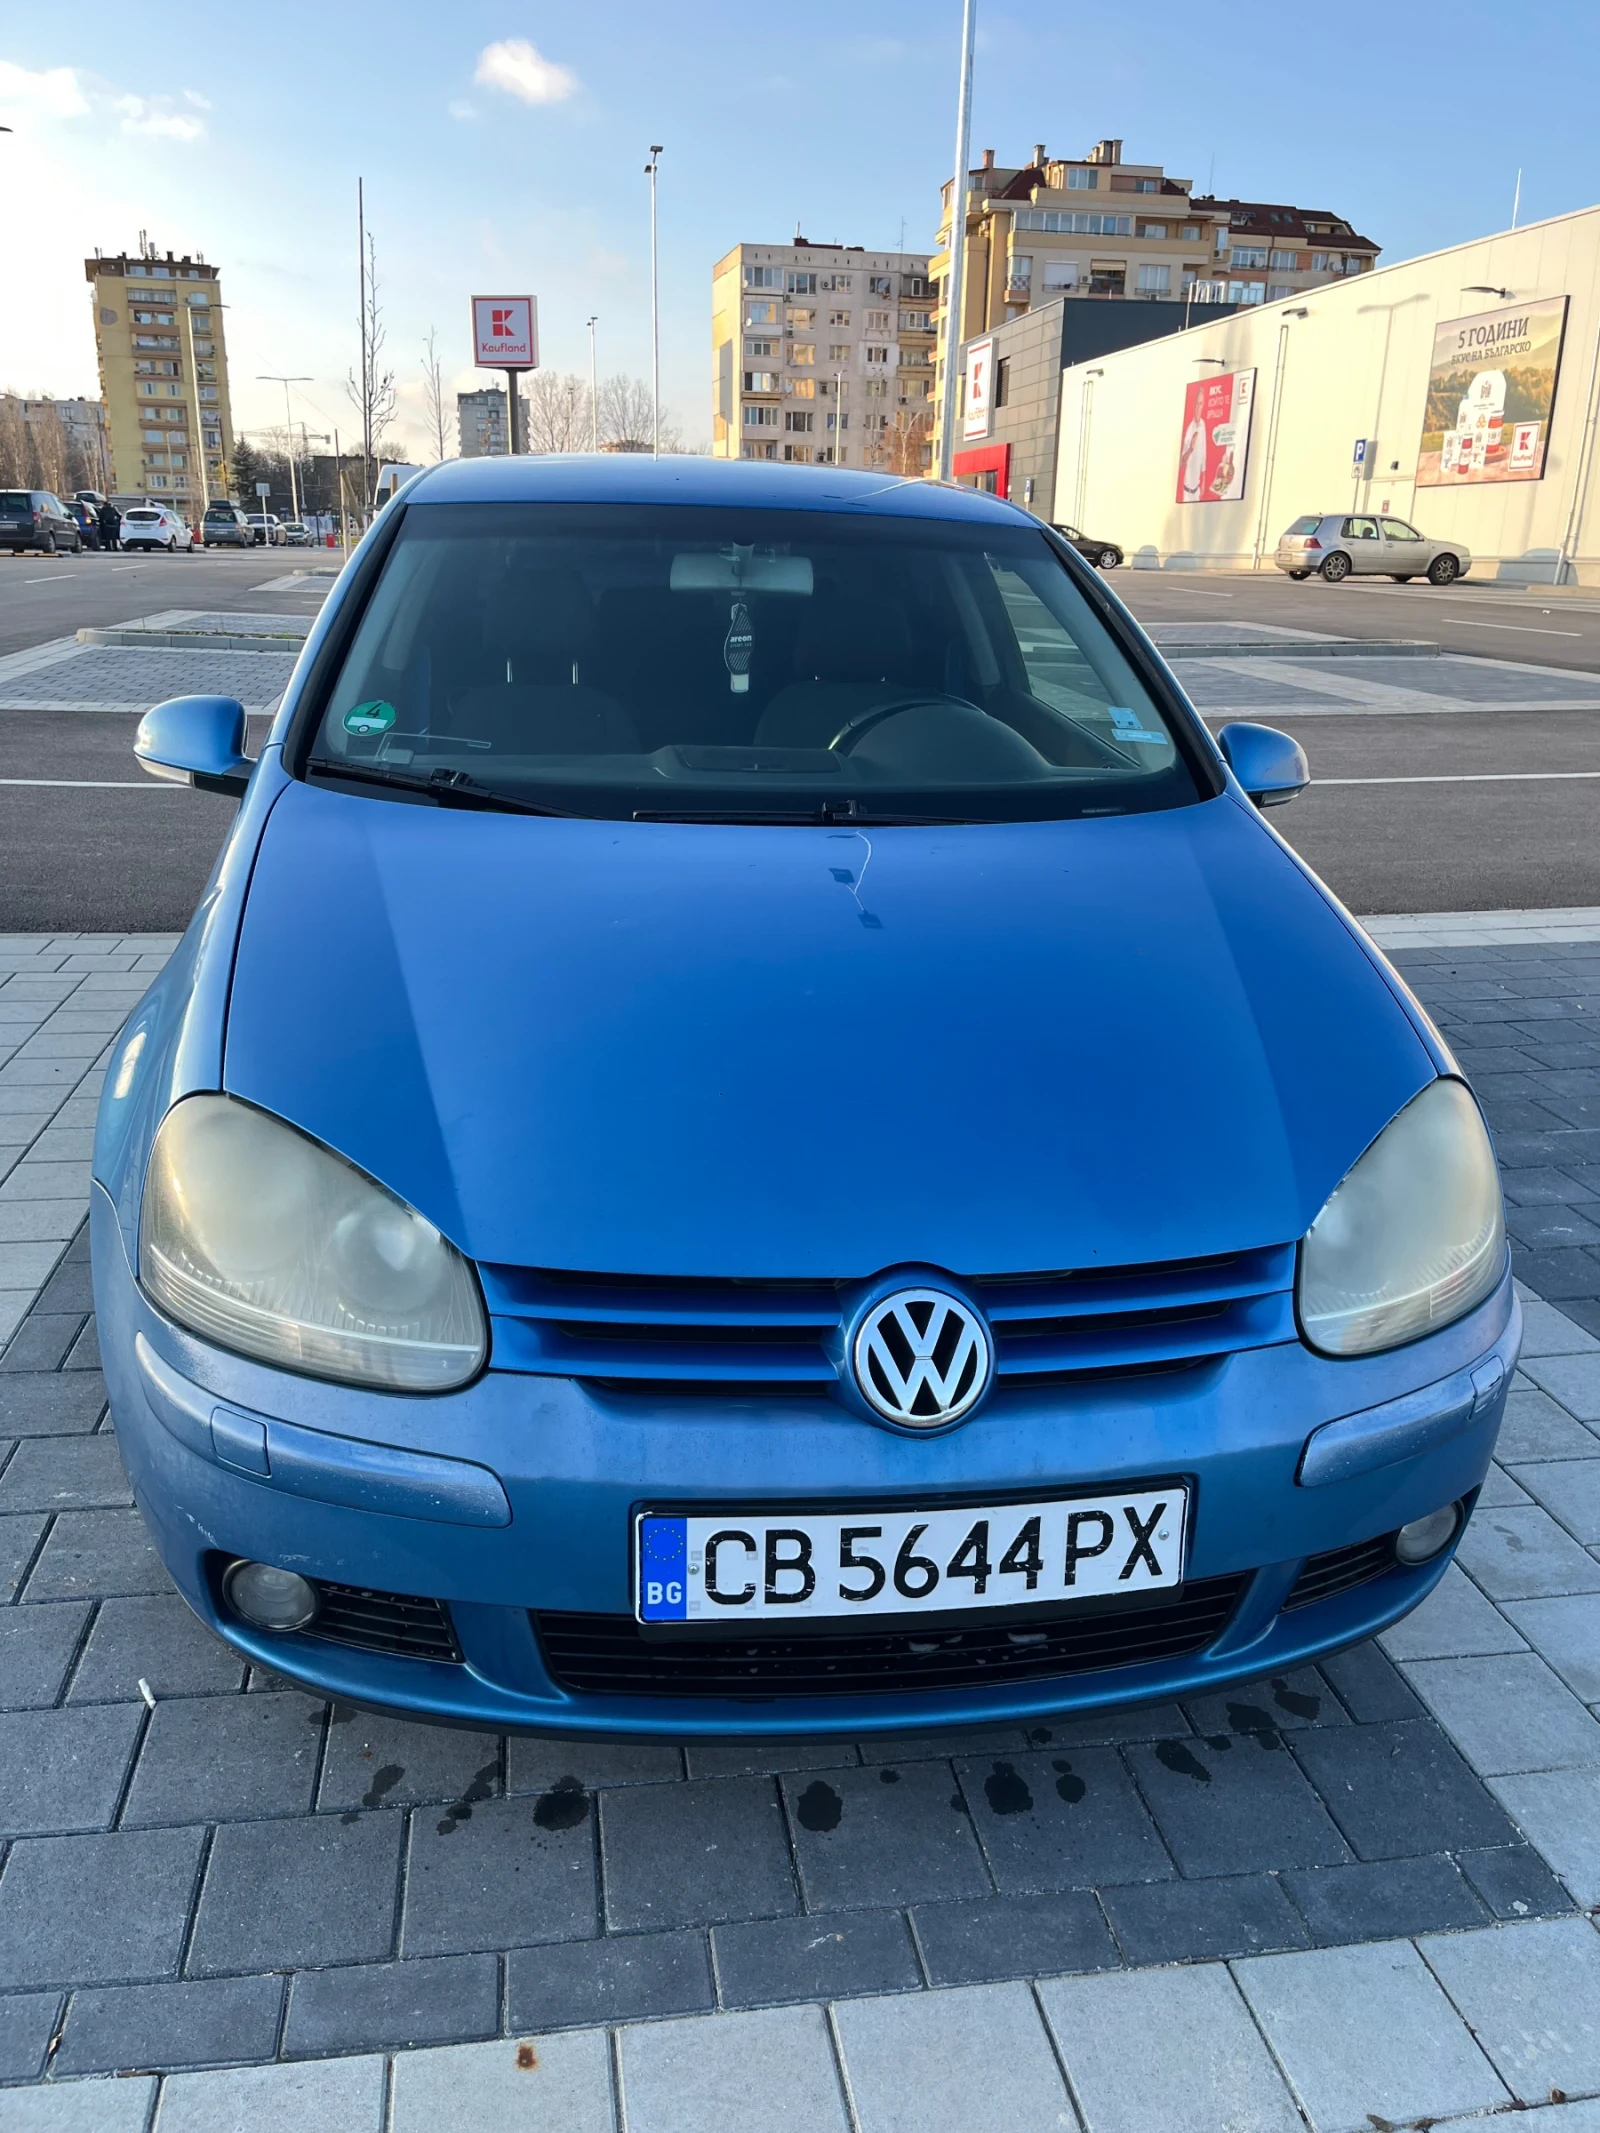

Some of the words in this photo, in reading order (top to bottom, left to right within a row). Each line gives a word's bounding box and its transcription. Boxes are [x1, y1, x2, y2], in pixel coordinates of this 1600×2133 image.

[1458, 330, 1466, 349] 5
[1468, 317, 1529, 347] ГОДИНИ
[481, 342, 526, 353] Kaufland
[1451, 352, 1471, 365] ВКУС
[1472, 350, 1482, 362] НА
[1484, 341, 1531, 359] БЪЛГАРСКО
[1356, 442, 1364, 461] P
[1513, 454, 1533, 462] Kaufland
[730, 635, 752, 643] areon
[366, 702, 382, 718] 4
[705, 1528, 815, 1605] CB
[839, 1516, 1044, 1602] 5644
[1064, 1503, 1167, 1587] PX
[647, 1581, 682, 1605] BG
